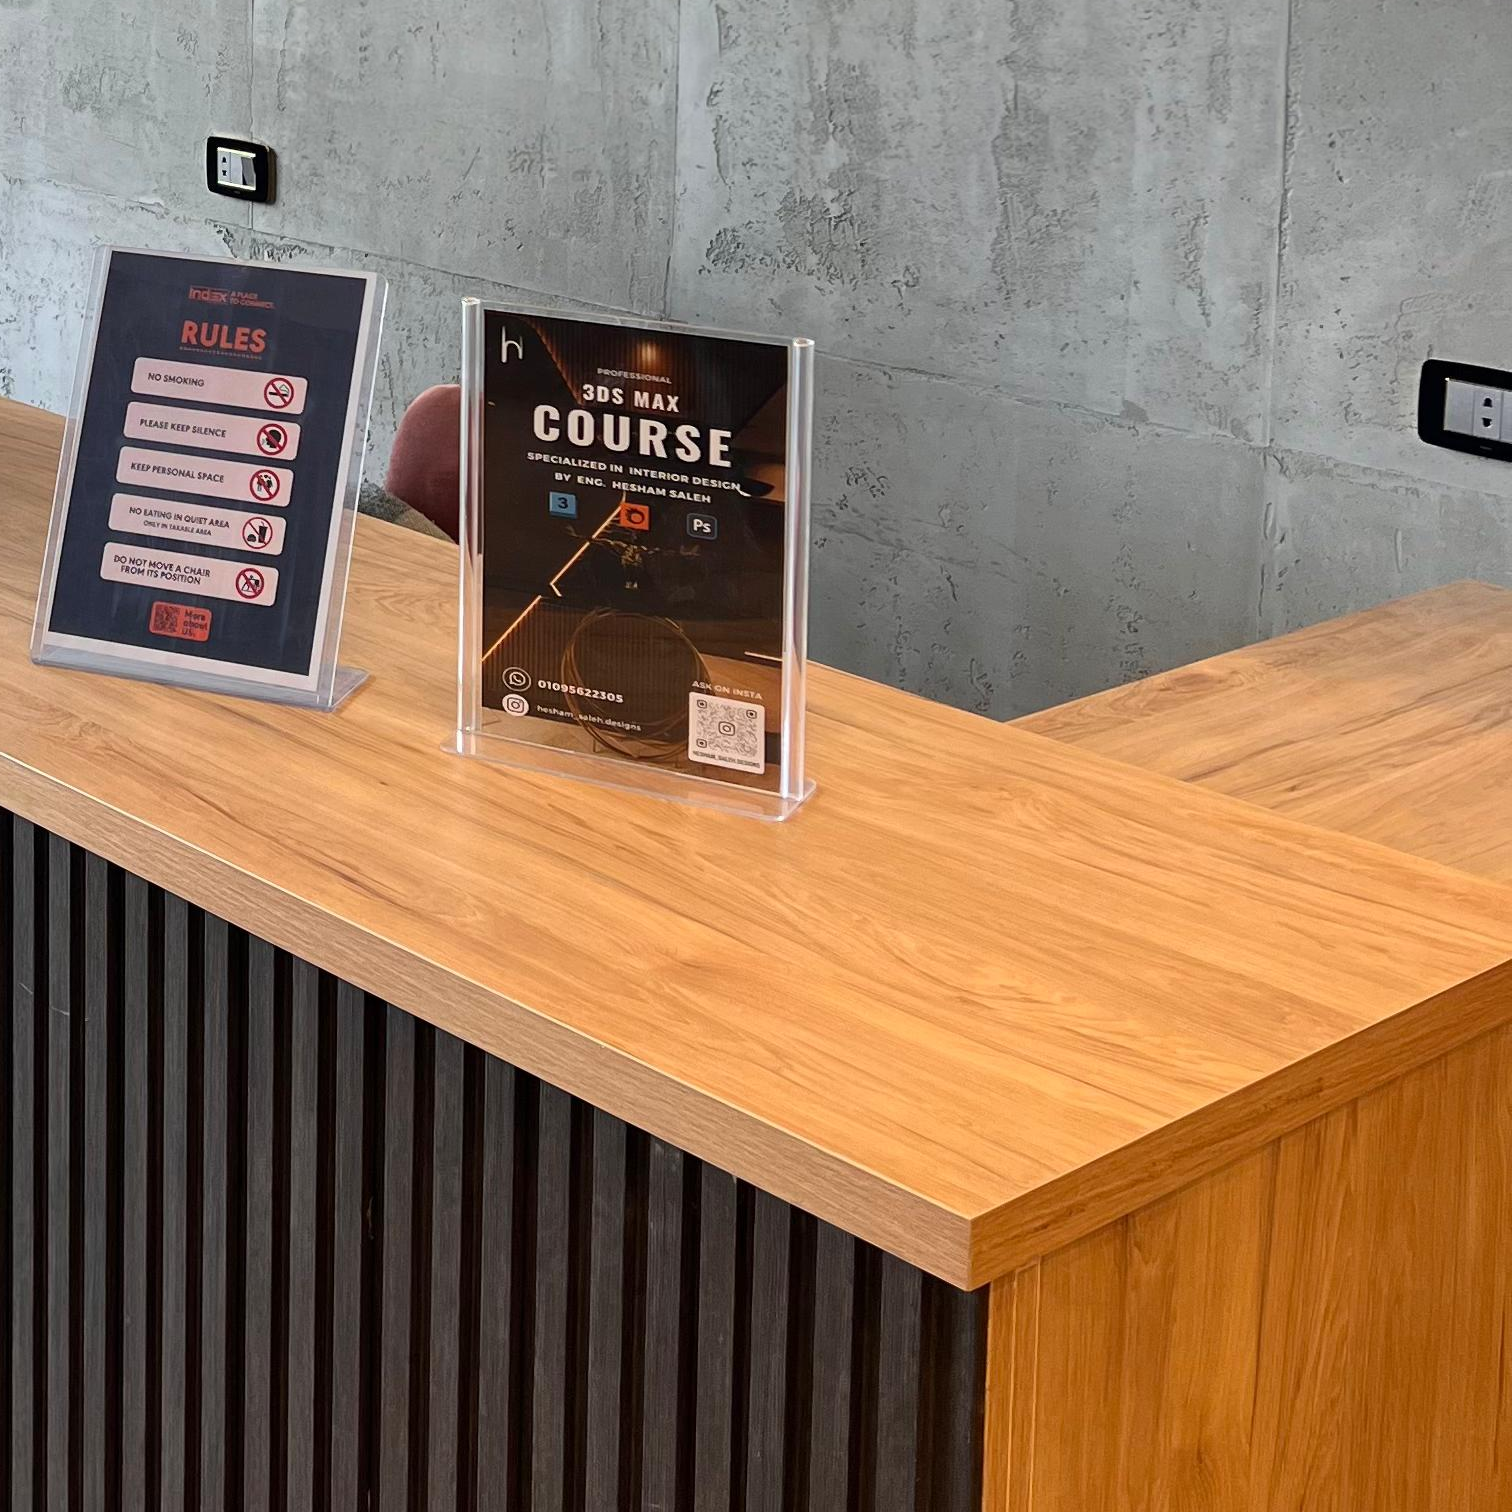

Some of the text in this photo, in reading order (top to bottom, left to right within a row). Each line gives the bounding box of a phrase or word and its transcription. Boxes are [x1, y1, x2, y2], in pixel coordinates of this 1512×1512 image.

[181, 320, 267, 353] RULES
[148, 373, 205, 387] NO SMOKING
[596, 367, 672, 385] PROFESSIONAL
[582, 383, 680, 413] 3DS MAX
[140, 418, 227, 438] PLEASE KEEP SILENCE
[533, 404, 732, 468] COURSE
[130, 462, 224, 483] KEEP PERSONAL SPACE
[527, 452, 741, 492] SPECIALIZED IN INTERIOR DESIGN
[554, 472, 711, 504] BY ENG. HESHAM SALEH
[129, 507, 230, 528] NO EATING IN QUIET AREA
[693, 519, 711, 533] Ps
[114, 555, 210, 577] DO NOT MOVE A CHAIR
[120, 565, 201, 584] FROM ITS POSITION
[537, 679, 624, 704] 01095622305
[691, 680, 762, 701] ASK ON INSTA
